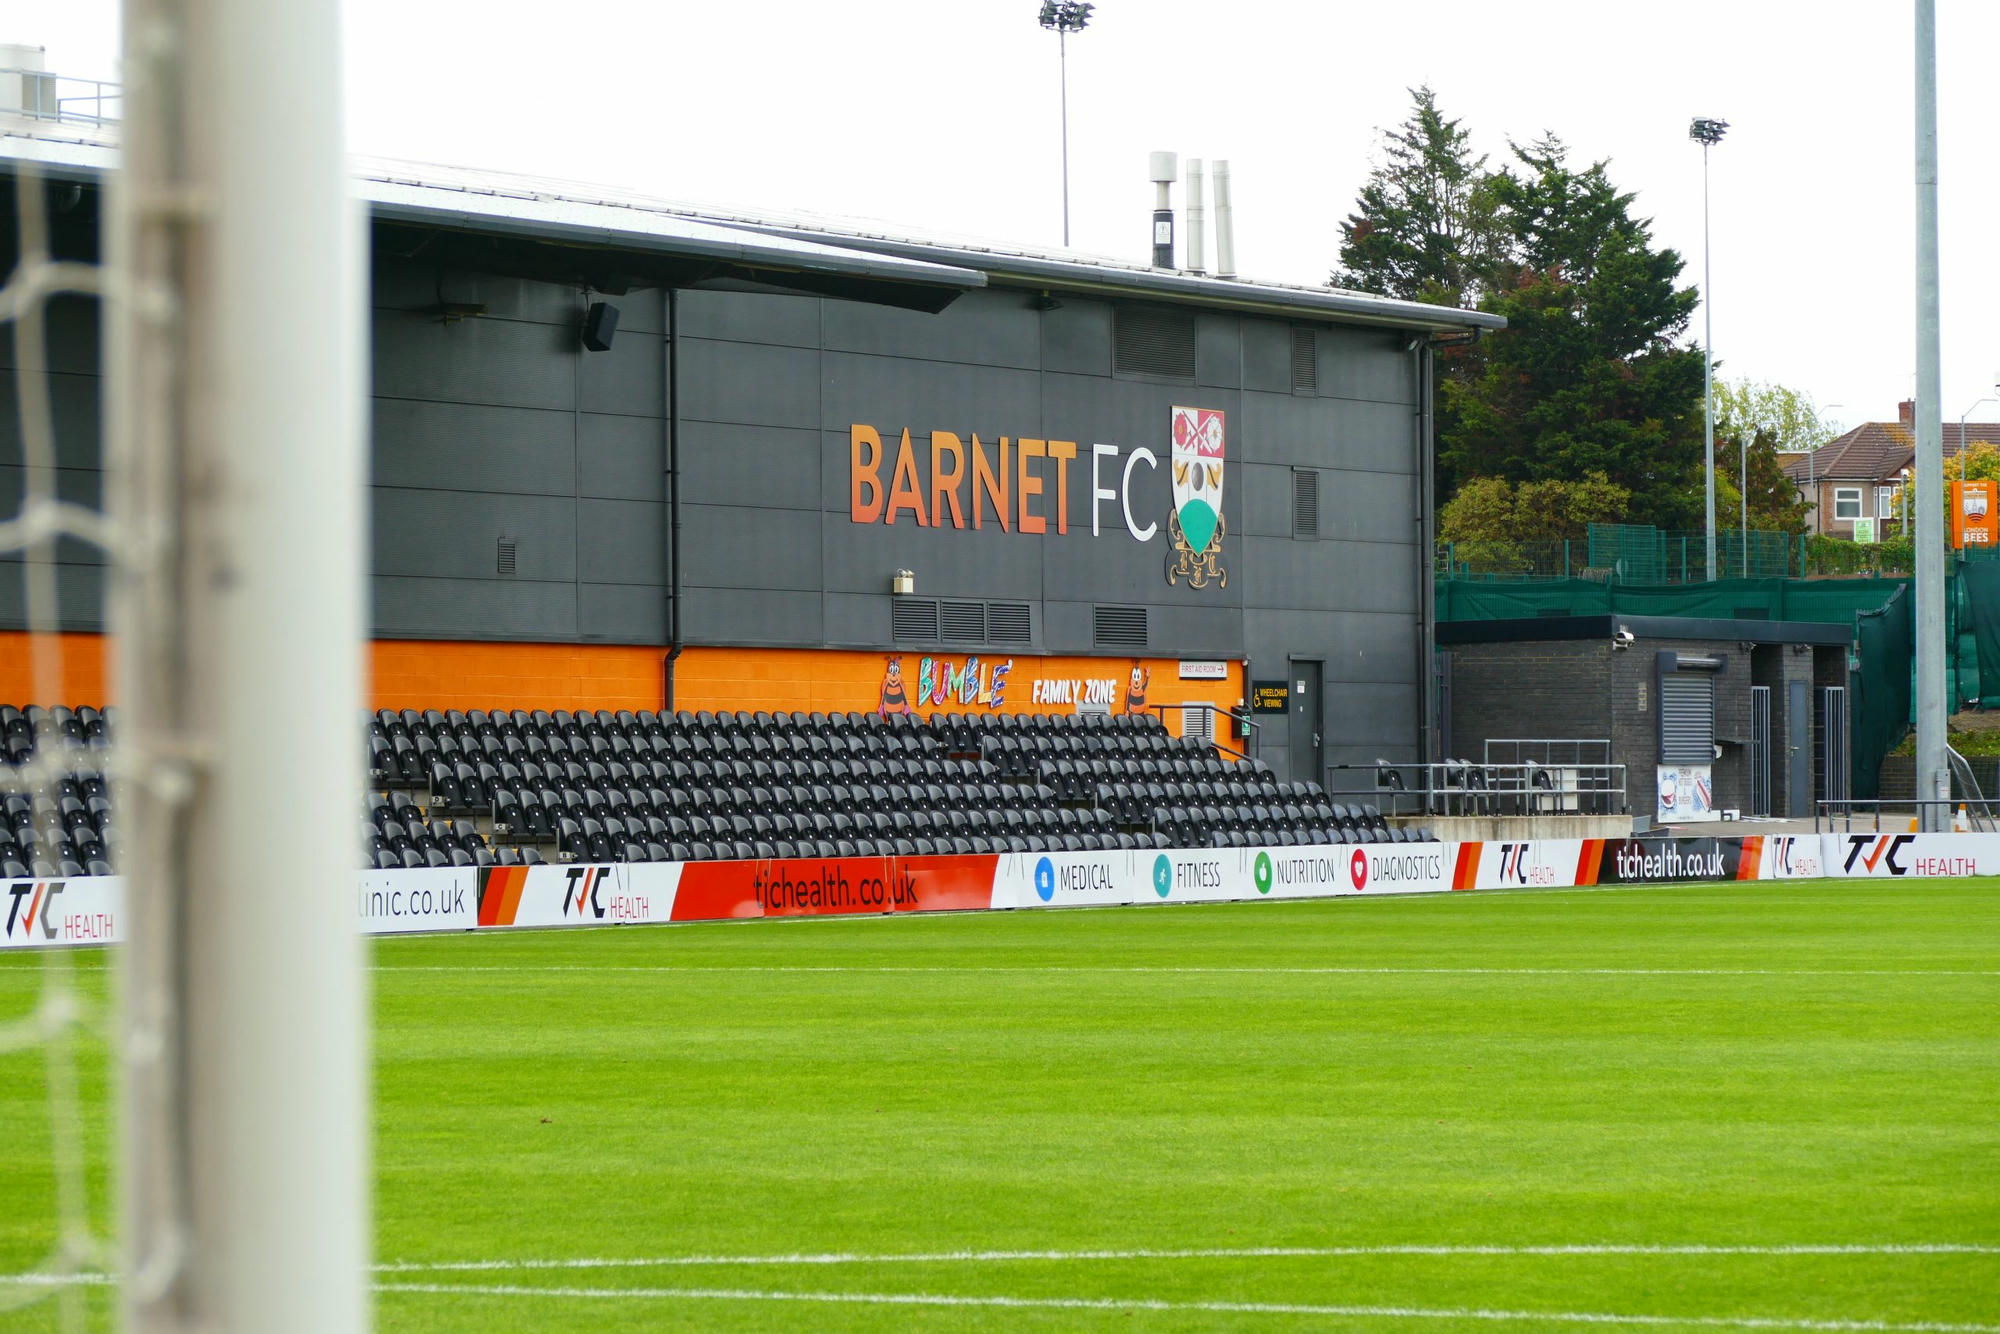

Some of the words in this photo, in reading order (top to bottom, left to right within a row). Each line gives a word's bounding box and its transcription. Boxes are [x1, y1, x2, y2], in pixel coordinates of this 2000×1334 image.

[851, 424, 1077, 535] BARNET
[1093, 443, 1157, 541] FC
[1964, 532, 1988, 542] BEES
[1032, 679, 1081, 704] FAMILY
[1084, 679, 1117, 704] ZONE
[1260, 688, 1288, 697] WHEELCHAIR
[1264, 699, 1282, 708] VIEWING
[1277, 858, 1335, 884] NUTRITION
[1372, 855, 1440, 881] DIAGNOSTICS
[1617, 842, 1726, 878] tichealth.co.uk
[1795, 858, 1817, 876] HEALTH
[1916, 858, 1976, 876] HEALTH
[754, 865, 919, 908] tichealth.co.uk
[1060, 864, 1114, 891] MEDICAL
[1177, 862, 1221, 887] FITNESS
[1530, 866, 1555, 885] HEALTH
[610, 896, 649, 918] HEALTH
[65, 914, 113, 939] HEALTH
